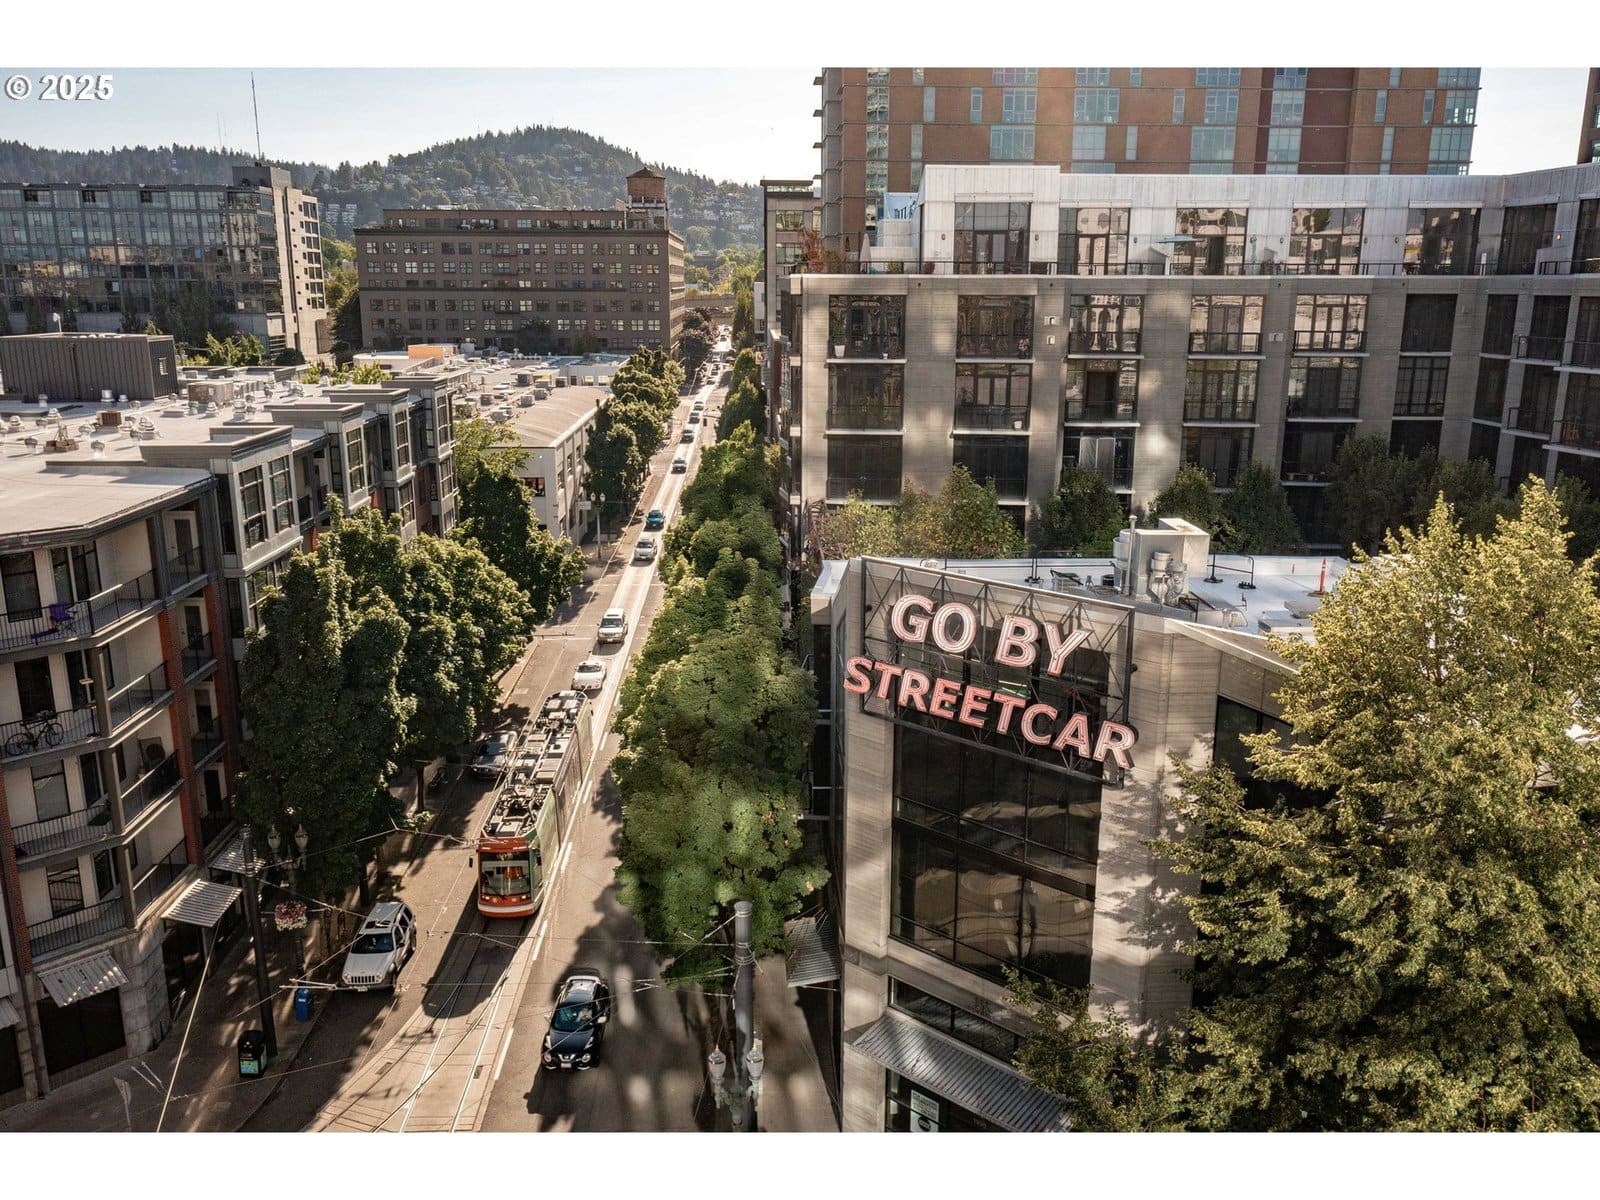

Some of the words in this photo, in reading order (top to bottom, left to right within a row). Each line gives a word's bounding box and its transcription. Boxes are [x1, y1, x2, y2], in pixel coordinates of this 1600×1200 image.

[891, 594, 977, 654] GO
[994, 614, 1093, 678] BY
[843, 656, 1138, 770] STREETCAR
